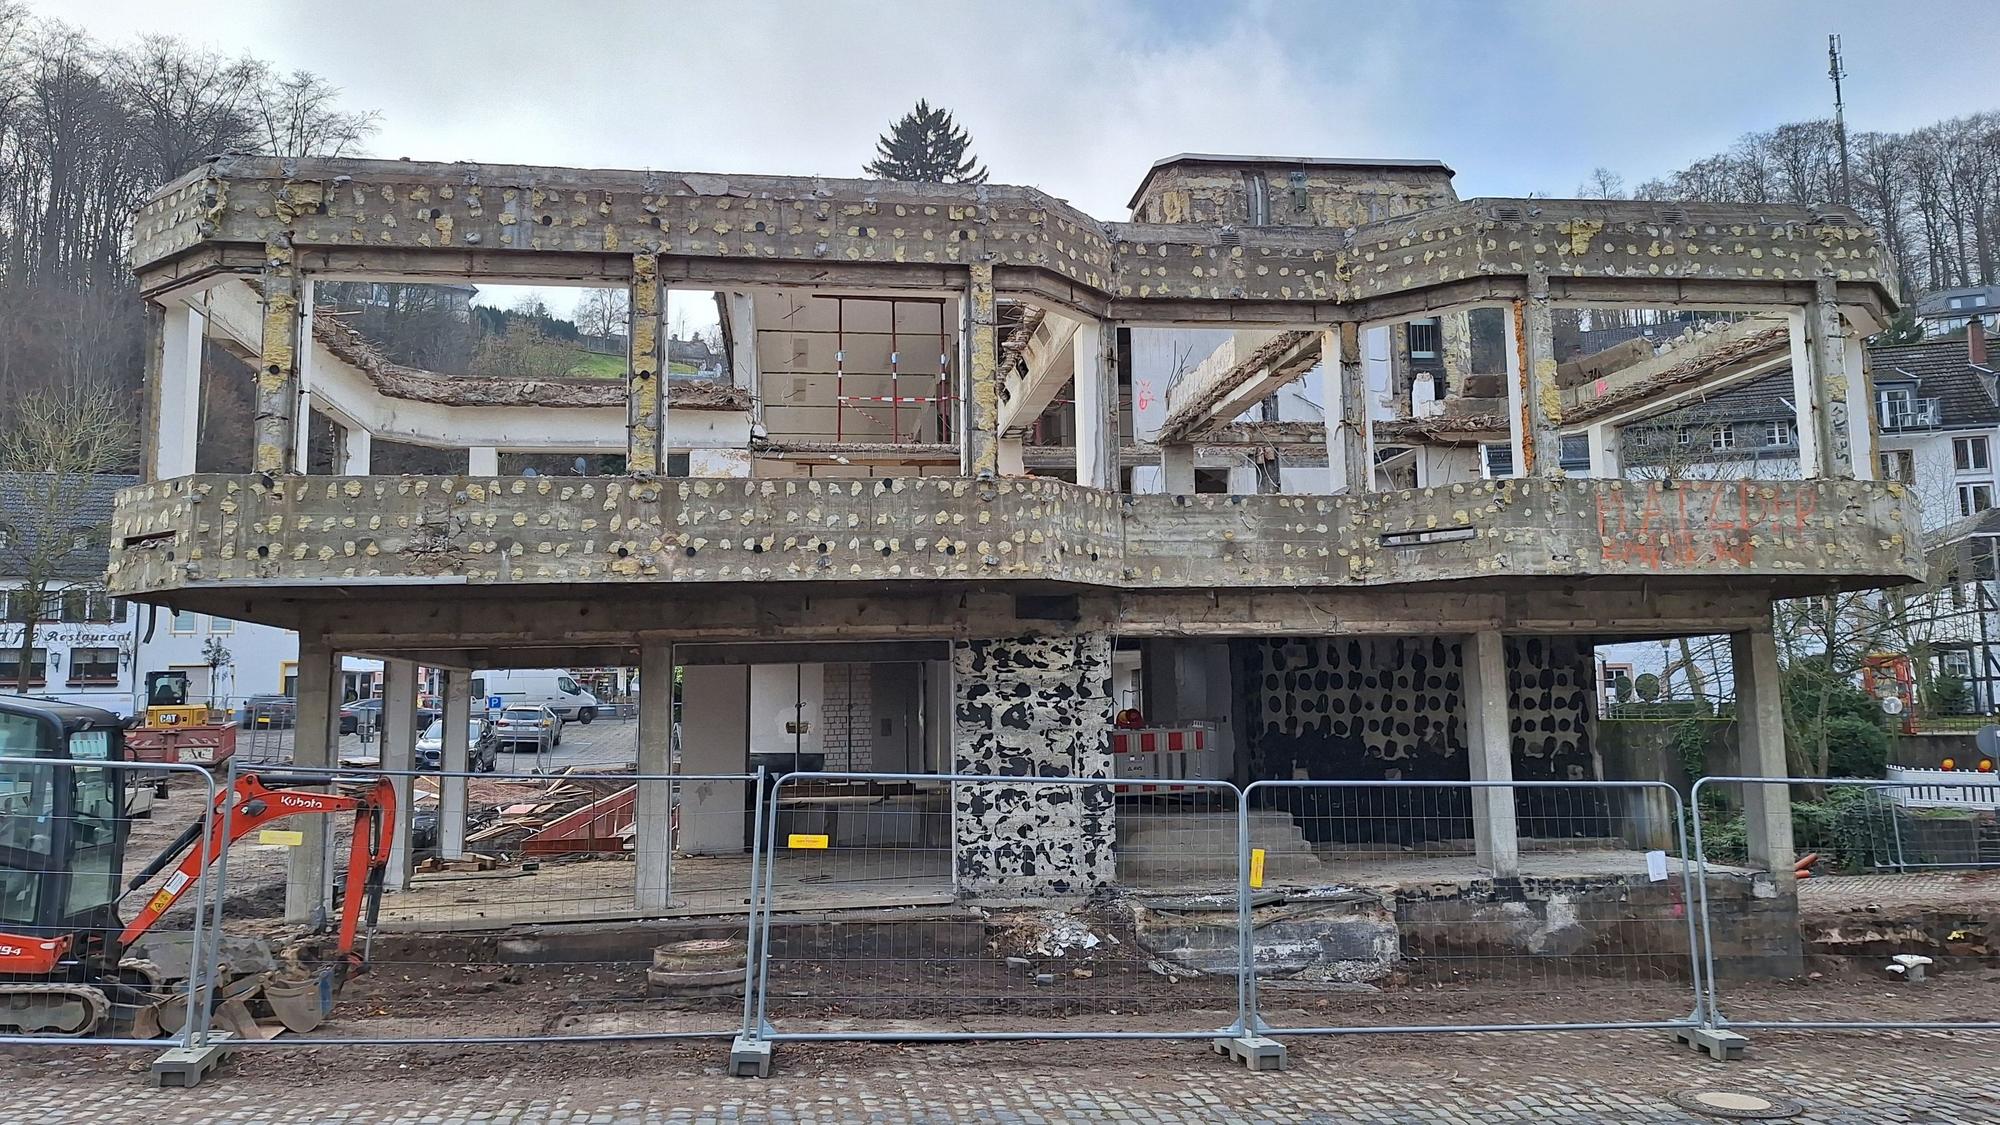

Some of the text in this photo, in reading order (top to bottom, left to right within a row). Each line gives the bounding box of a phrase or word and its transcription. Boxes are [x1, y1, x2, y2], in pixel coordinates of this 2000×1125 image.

[0, 627, 132, 645] afé Restaurant
[160, 713, 177, 723] CAT
[280, 796, 323, 809] Kubota
